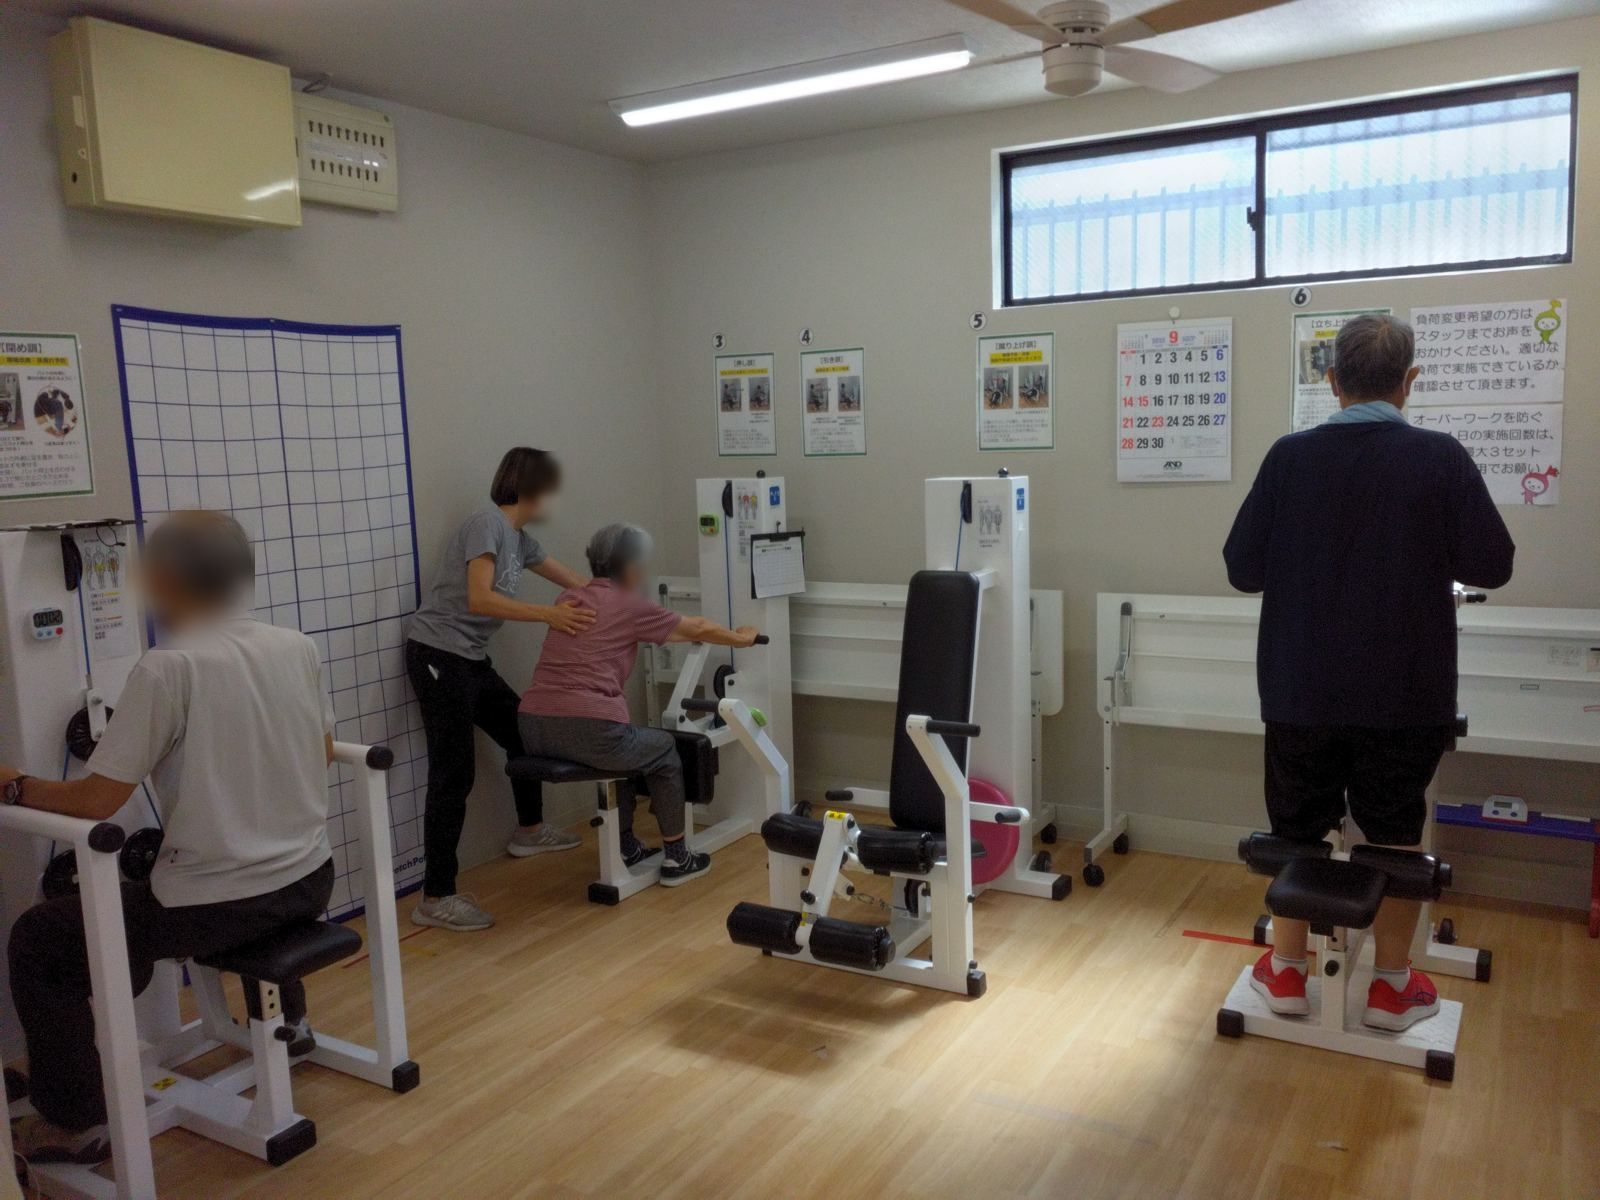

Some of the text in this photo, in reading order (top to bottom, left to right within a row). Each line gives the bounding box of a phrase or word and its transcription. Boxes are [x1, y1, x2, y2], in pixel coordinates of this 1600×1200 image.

[1294, 288, 1307, 305] 6
[973, 314, 983, 329] 5
[1416, 308, 1534, 325] 負荷変更希望の方は
[801, 329, 811, 344] 4
[1168, 330, 1178, 344] 9
[1415, 325, 1532, 342] スタッフまでお声を
[715, 335, 723, 348] 3
[1140, 349, 1224, 364] 1 2 3 4 5 6
[1415, 341, 1559, 359] おかけください。適切な
[1124, 371, 1226, 387] 7 8 9 10 11 12 13
[1414, 377, 1536, 392] 確認させて頂きます。
[1122, 392, 1226, 407] 14 15 16 17 18 19 20
[1122, 414, 1226, 429] 21 22 23 24 25 26 27
[1414, 411, 1543, 426] オーバーワークを防ぐ
[1448, 428, 1555, 441] 日の実施回数は、
[1122, 437, 1164, 449] 28 29 30
